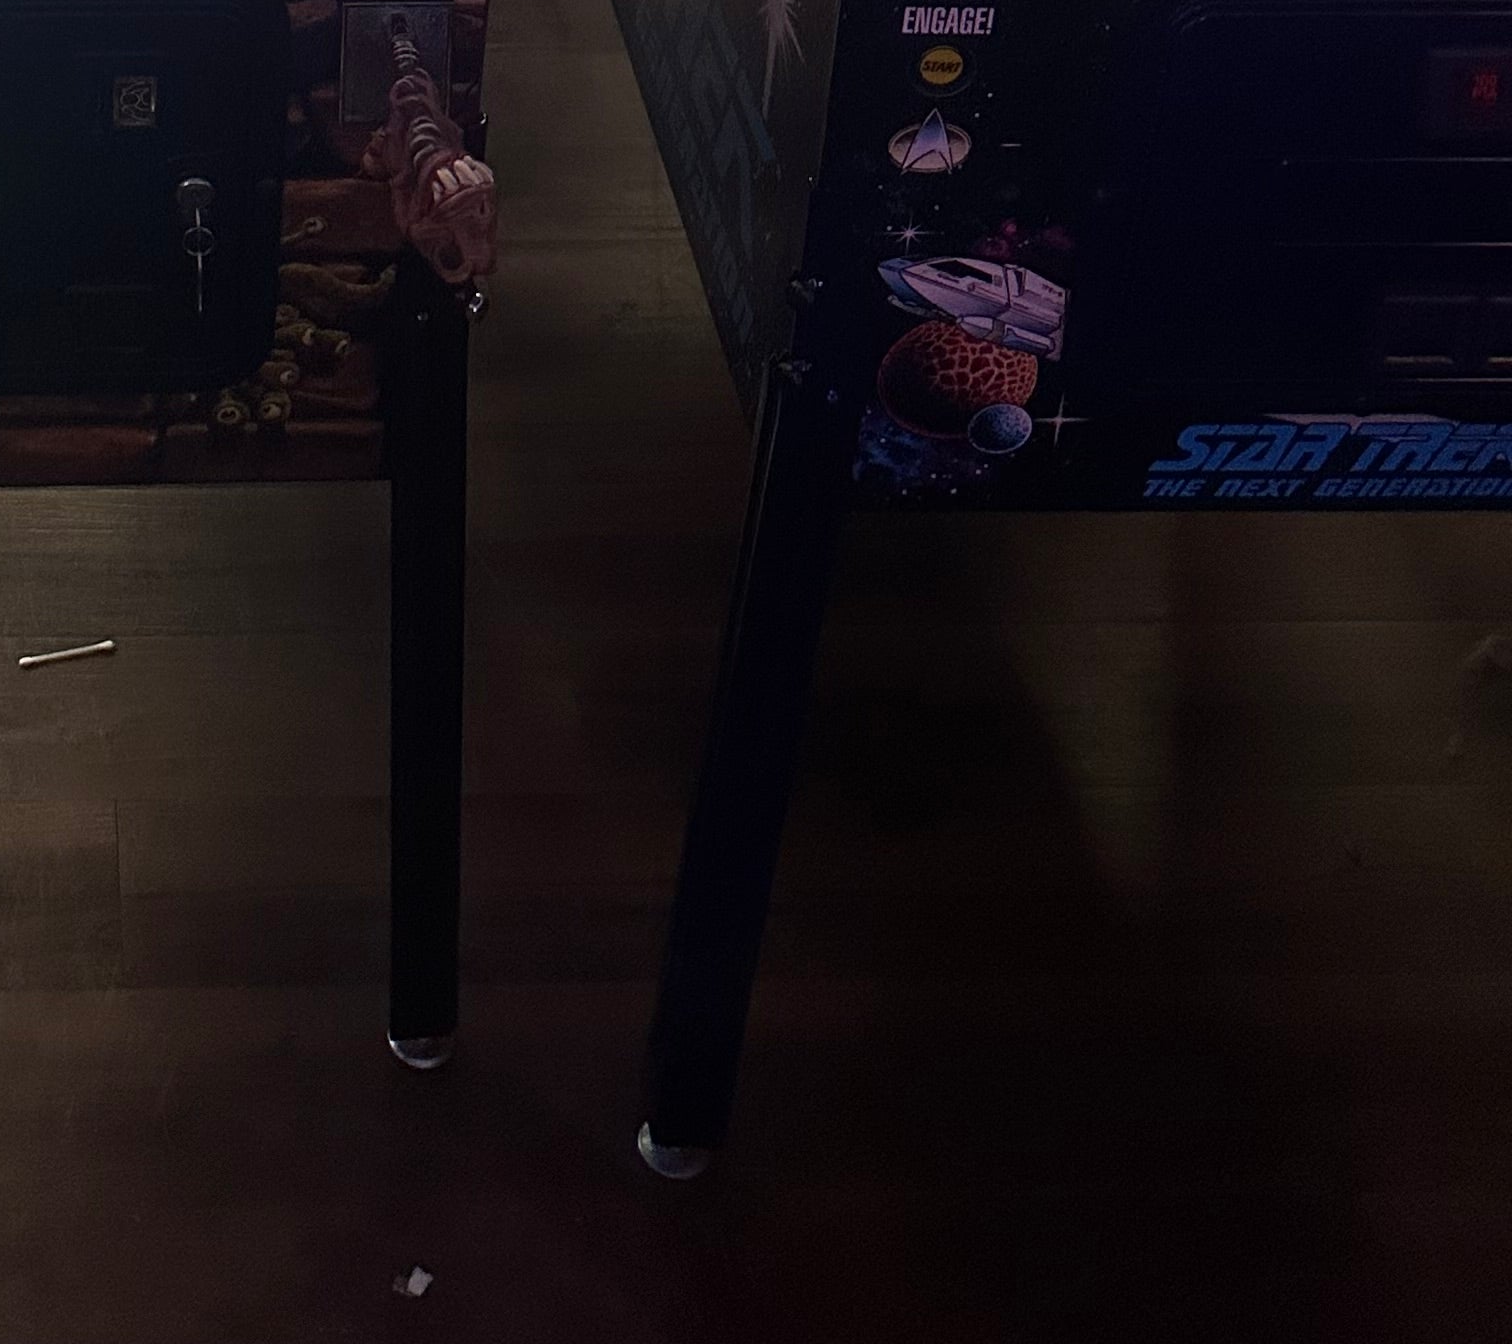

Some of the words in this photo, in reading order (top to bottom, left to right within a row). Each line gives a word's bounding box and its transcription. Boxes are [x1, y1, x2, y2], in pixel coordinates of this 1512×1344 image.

[901, 6, 995, 35] ENGAGE!
[922, 60, 962, 73] START
[1148, 423, 1351, 472] STAR
[1143, 478, 1206, 498] THE
[1214, 478, 1305, 498] NEXT
